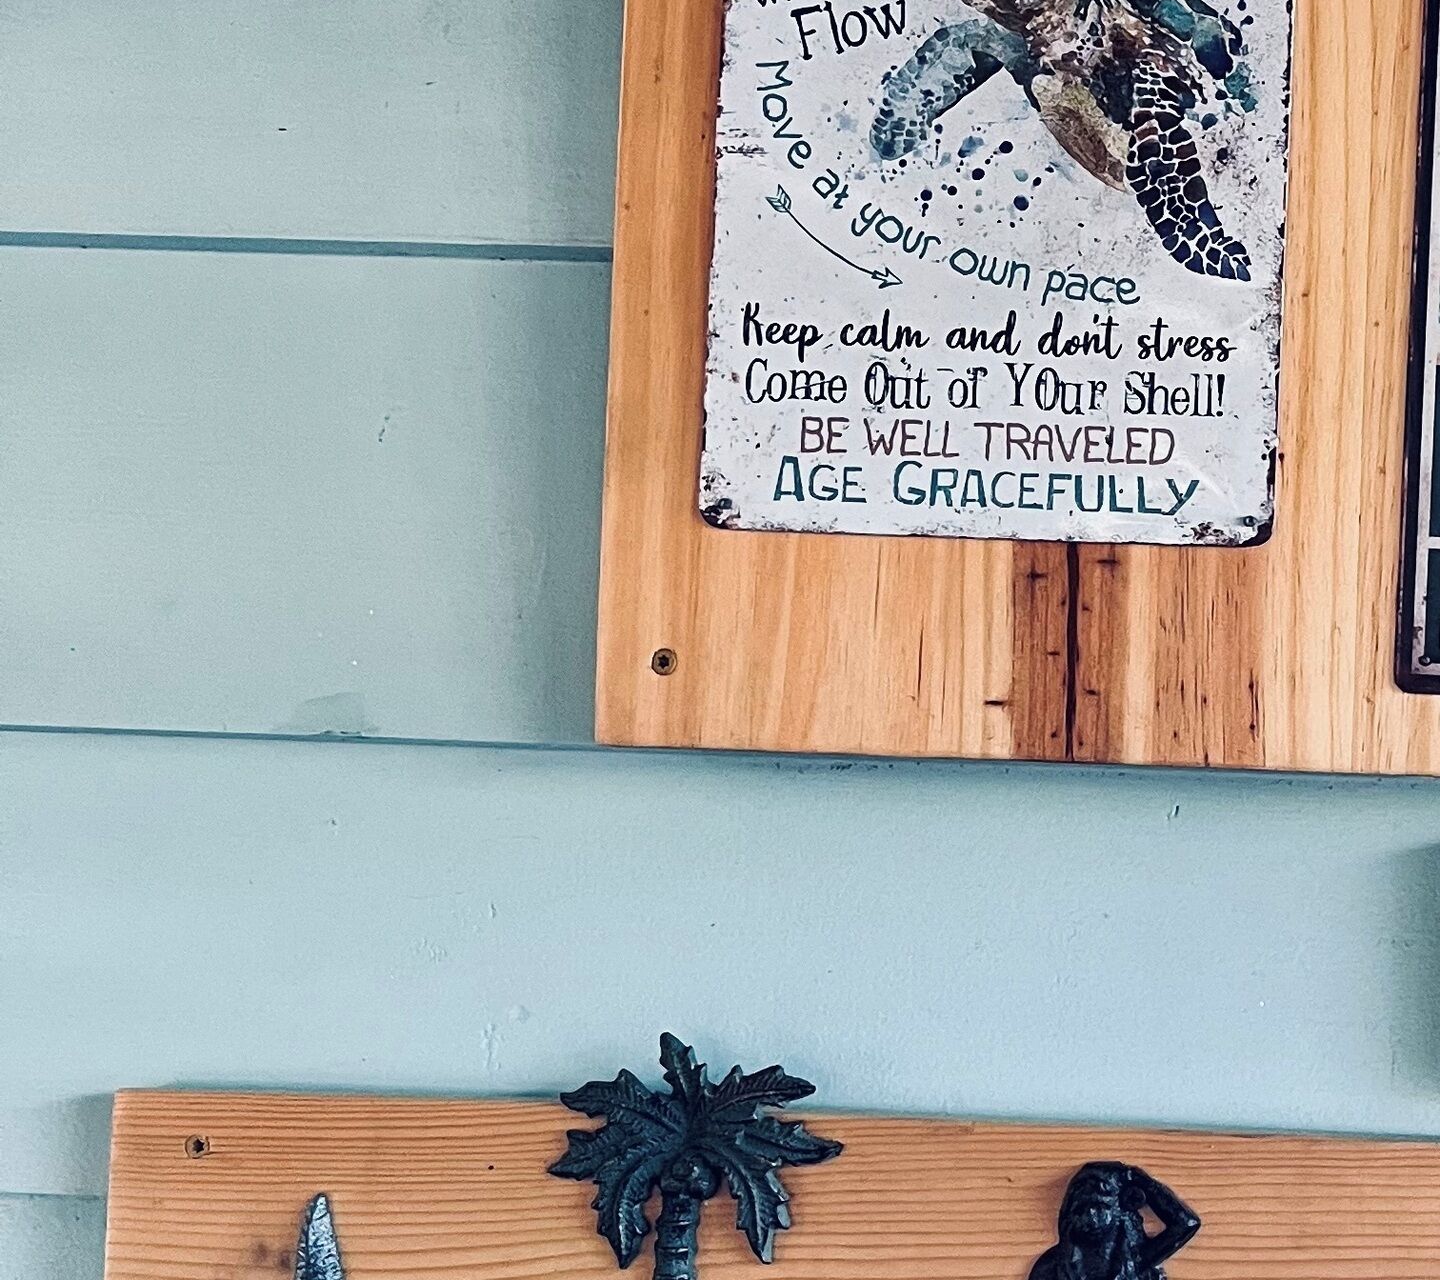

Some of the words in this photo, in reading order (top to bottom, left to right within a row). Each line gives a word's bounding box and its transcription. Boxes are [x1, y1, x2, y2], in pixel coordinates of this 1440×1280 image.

[790, 0, 907, 60] Flow
[755, 60, 813, 170] Move
[812, 168, 850, 210] at
[851, 200, 941, 260] your
[949, 247, 1031, 292] own
[1041, 266, 1141, 307] pace
[741, 301, 823, 363] Keep
[840, 309, 930, 351] calm
[946, 310, 1022, 357] and
[1038, 311, 1123, 360] don't
[1137, 317, 1237, 363] stress
[745, 358, 848, 404] Come
[864, 361, 931, 410] Out
[948, 366, 989, 410] of
[1123, 370, 1226, 417] Shell!
[800, 416, 849, 453] BE
[863, 417, 959, 458] WELL
[973, 421, 1176, 466] TRAVELED
[773, 456, 867, 503] AGE
[893, 459, 1200, 516] GRACEFULLY
